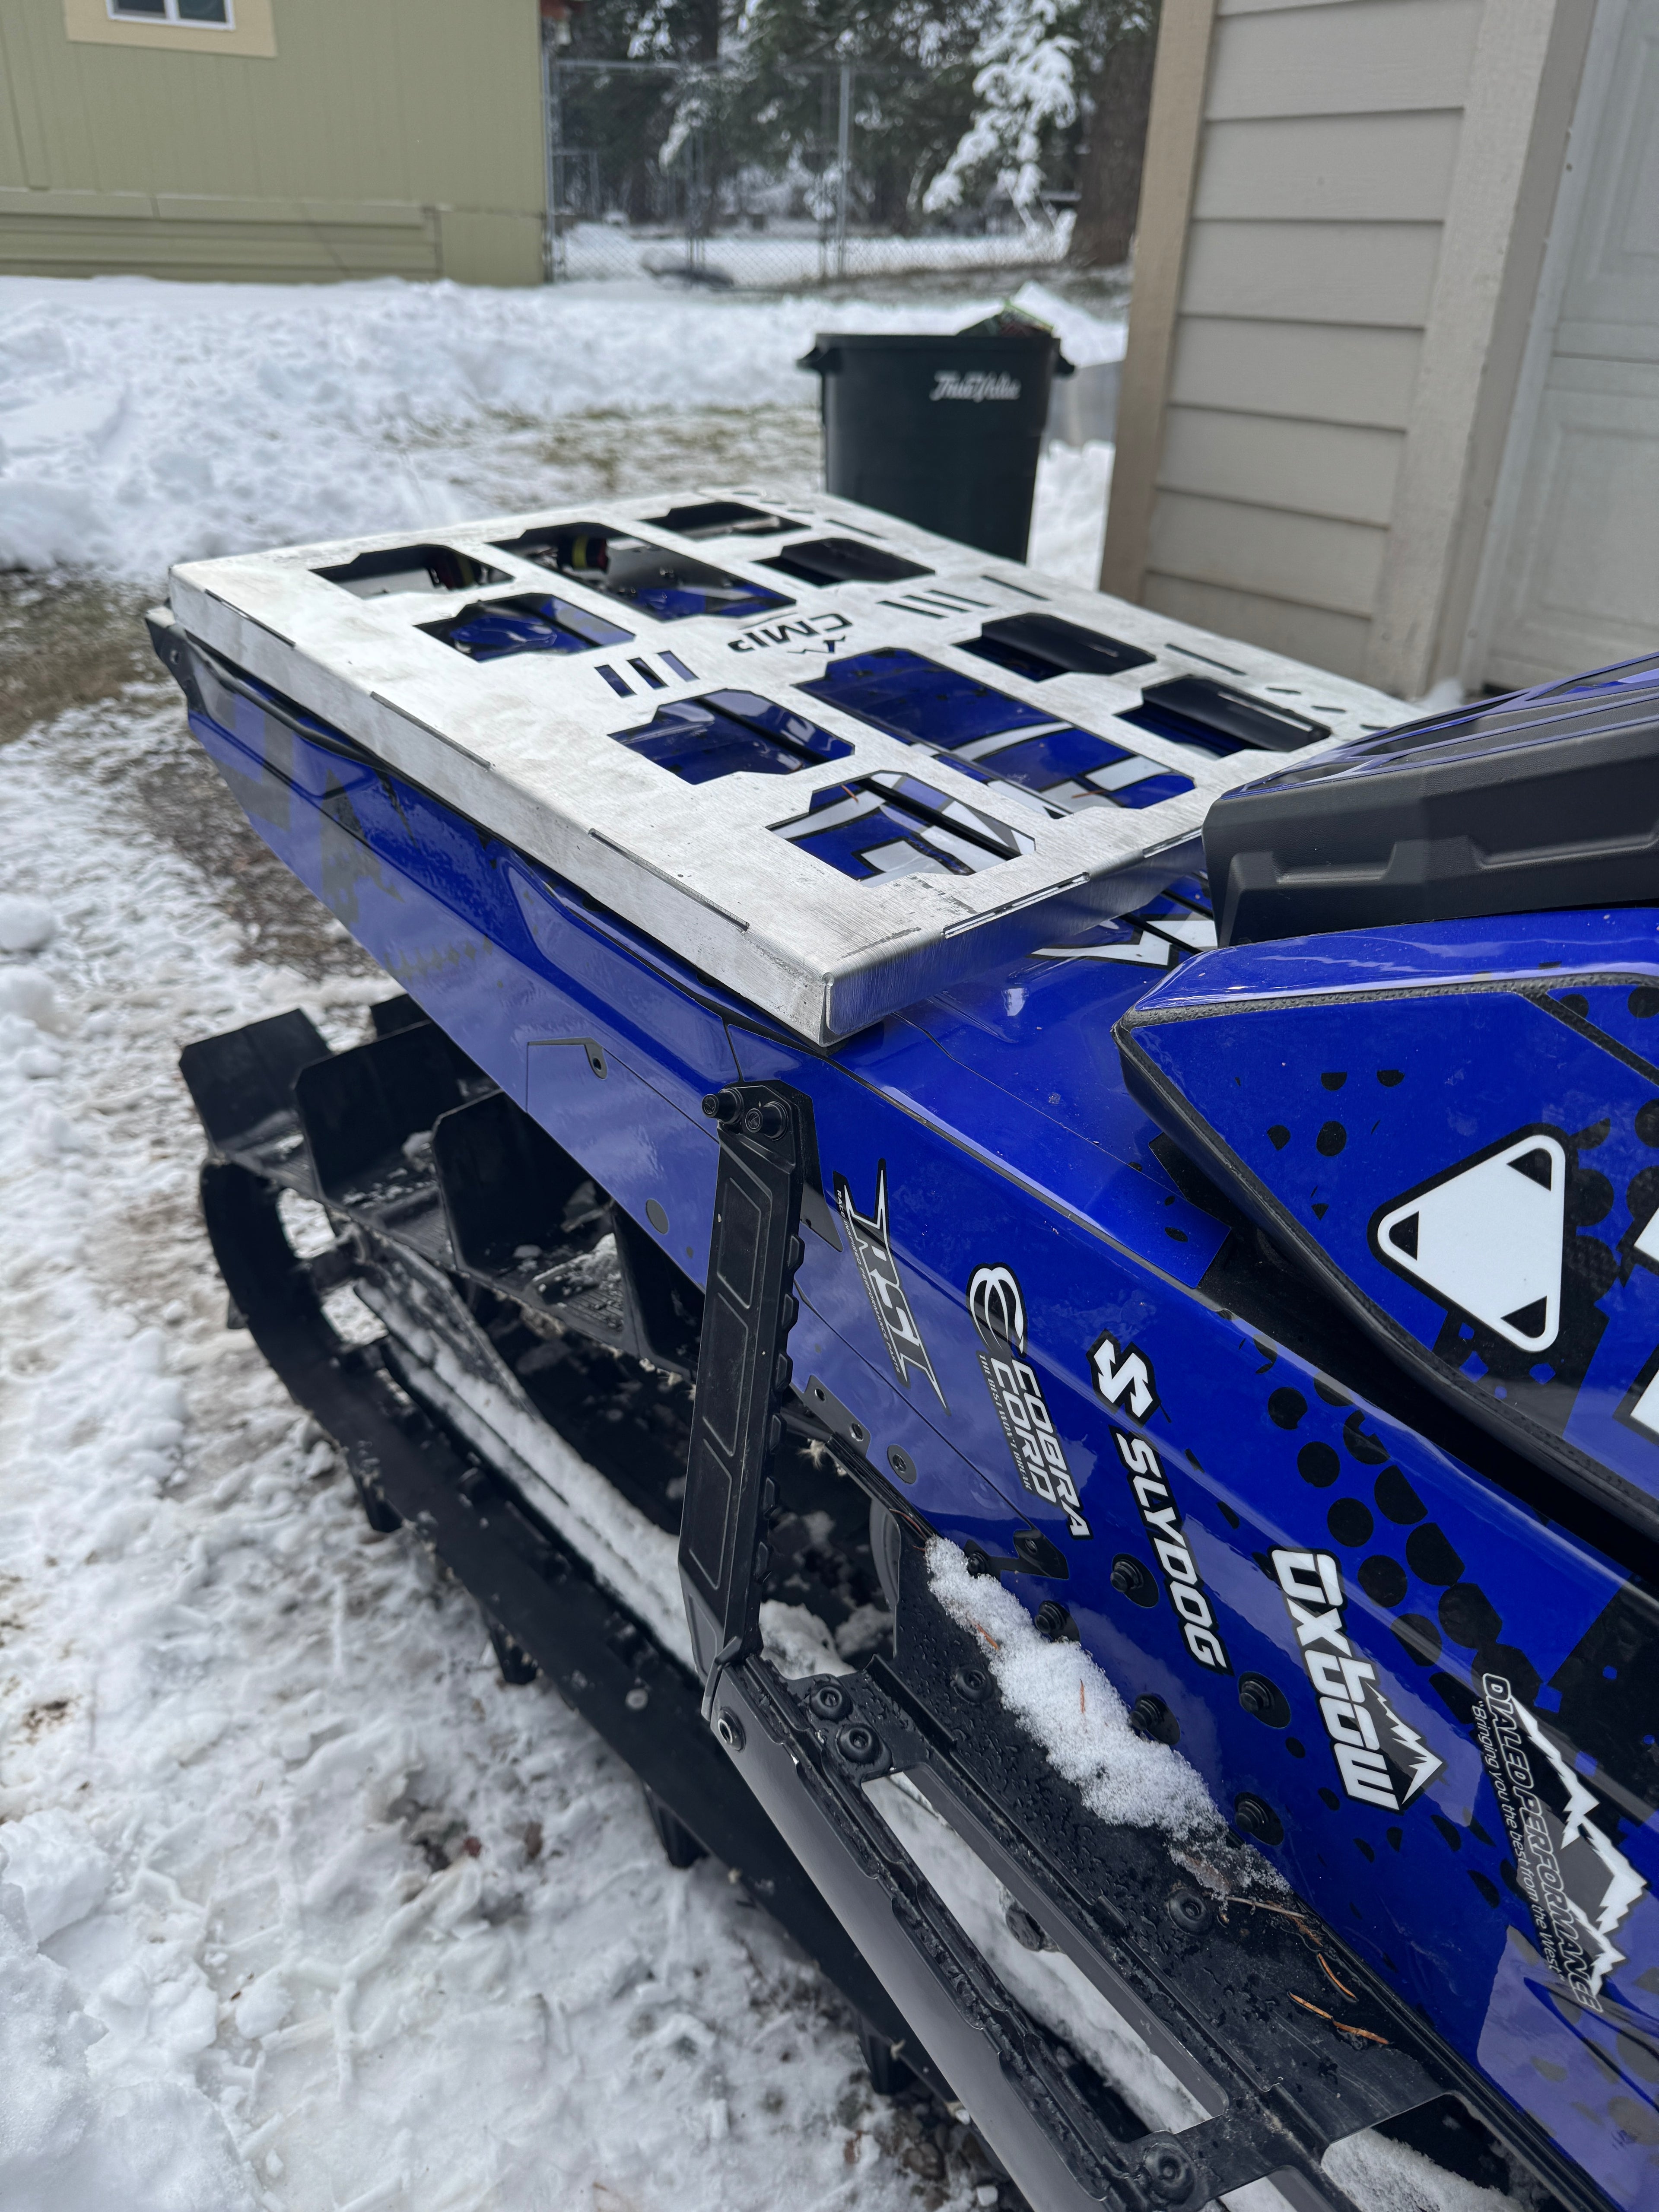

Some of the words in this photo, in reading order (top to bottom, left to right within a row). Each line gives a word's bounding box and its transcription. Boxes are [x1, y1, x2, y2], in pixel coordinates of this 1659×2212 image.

[836, 1189, 845, 1218] RACE
[843, 1219, 861, 1265] INSPIRED
[860, 1267, 888, 1340] PERFORMANCE
[886, 1341, 901, 1373] PARTS
[844, 1170, 946, 1408] RSI
[979, 1354, 992, 1376] THE
[988, 1378, 1004, 1411] BEST
[998, 1410, 1017, 1452] WON'T
[1013, 1450, 1033, 1491] BREAK
[991, 1357, 1057, 1503] CORD
[1011, 1359, 1090, 1535] COBRA
[1116, 1433, 1227, 1669] SLYDOG
[1482, 1673, 1534, 1789] DIALED
[1513, 1786, 1603, 2013] PERFORMANCE
[1489, 1770, 1510, 1802] you
[1501, 1803, 1517, 1829] the
[1510, 1830, 1531, 1866] best
[1520, 1865, 1539, 1901] from
[1531, 1904, 1547, 1929] the
